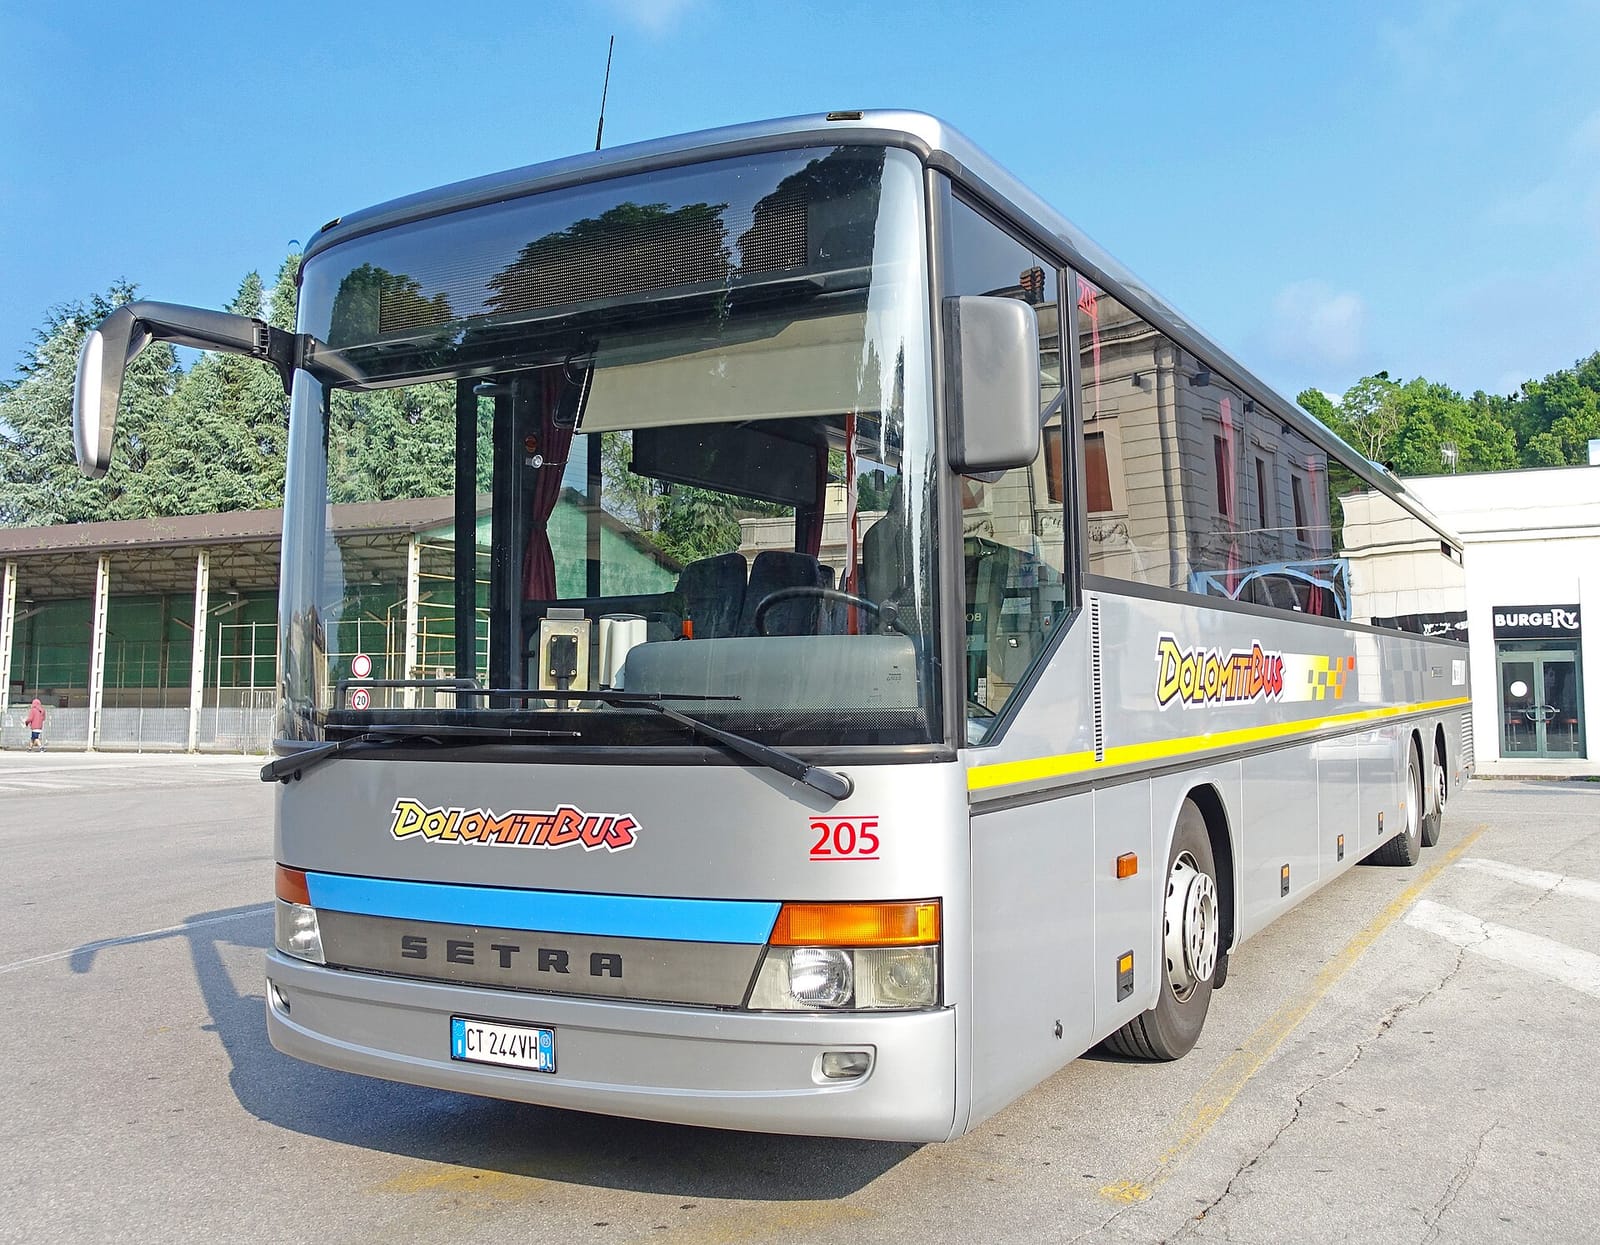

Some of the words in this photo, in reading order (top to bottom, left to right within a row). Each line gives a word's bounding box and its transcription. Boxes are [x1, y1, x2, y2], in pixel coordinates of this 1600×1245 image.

[1494, 608, 1579, 629] BURGERY
[356, 695, 366, 705] 20
[809, 821, 880, 855] 205
[401, 935, 623, 978] SETRA
[466, 1028, 484, 1053] CT
[489, 1031, 539, 1061] 244VH
[540, 1052, 553, 1068] BL
